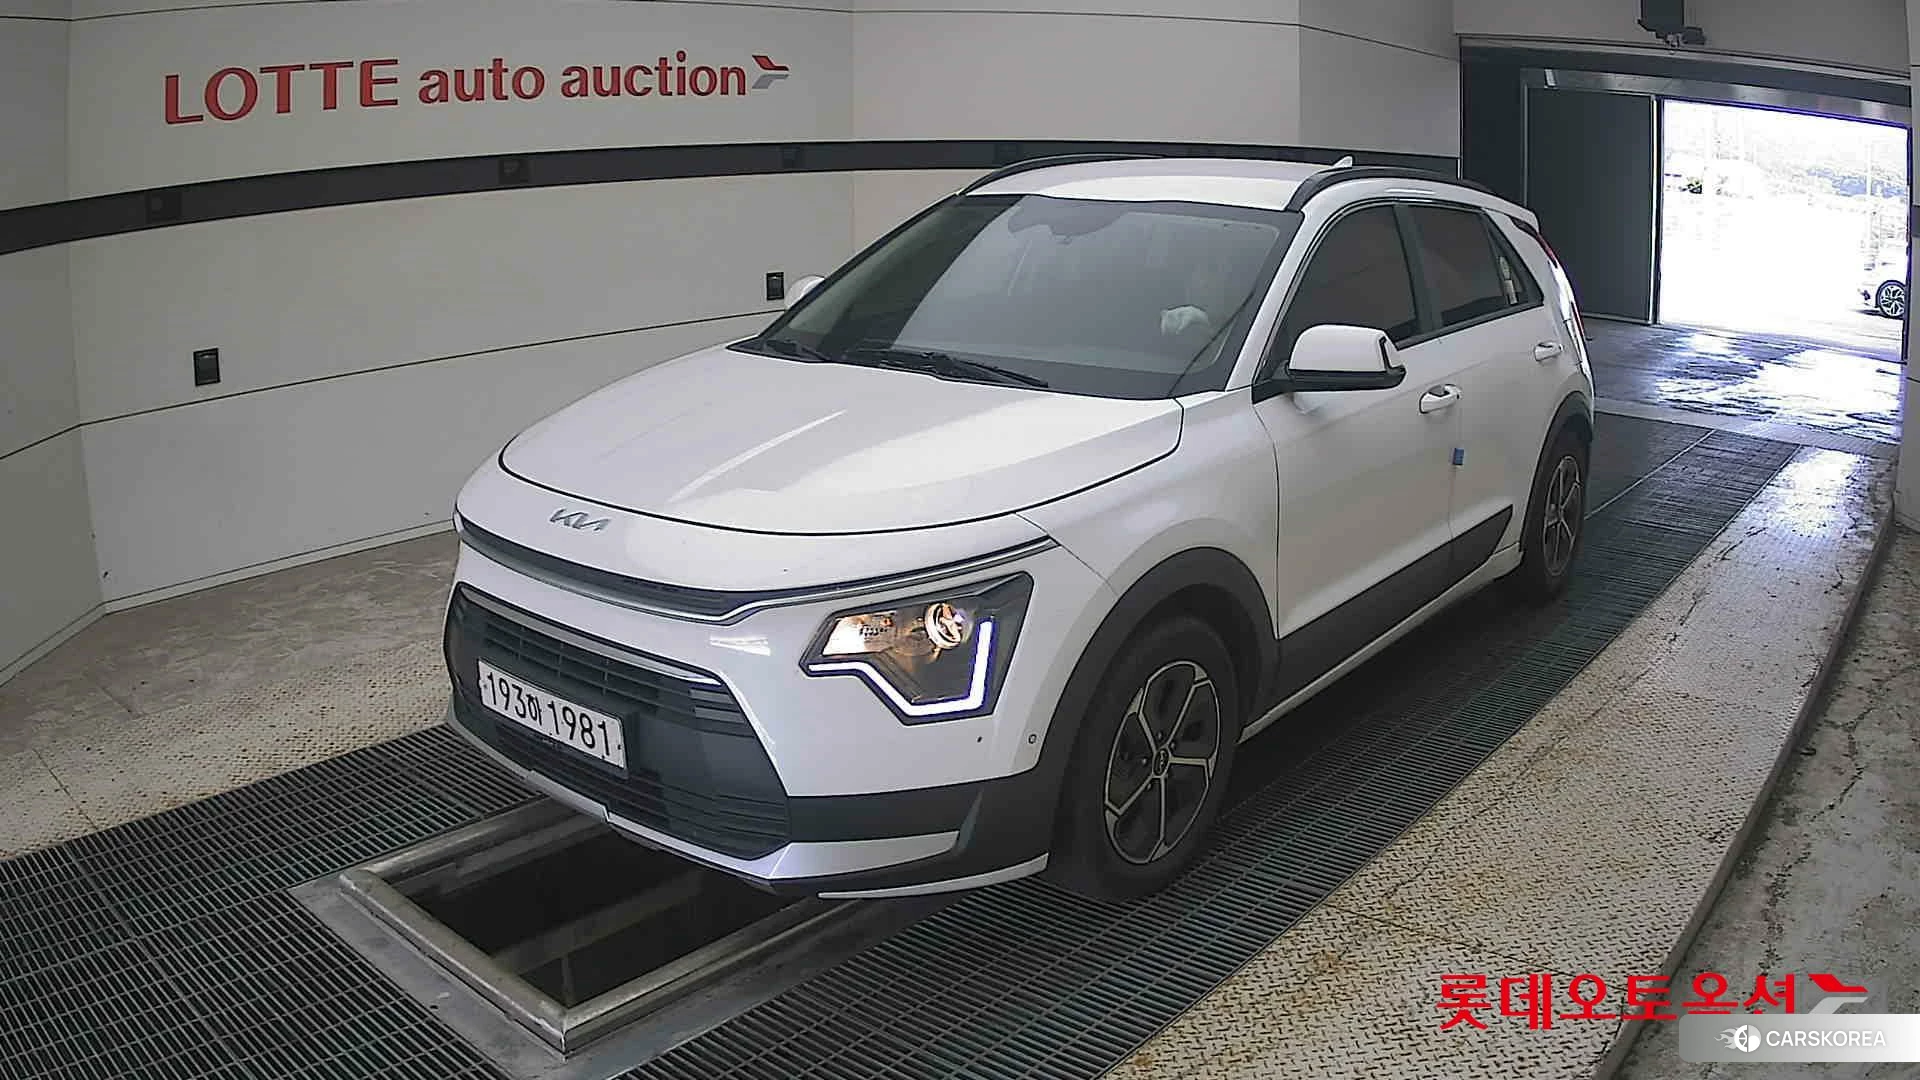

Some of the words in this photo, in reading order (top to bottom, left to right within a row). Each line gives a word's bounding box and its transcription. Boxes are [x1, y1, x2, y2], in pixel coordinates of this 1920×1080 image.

[165, 58, 399, 125] LOTTE
[418, 57, 546, 104] auto
[561, 50, 748, 98] auction
[549, 508, 609, 532] KIA
[488, 672, 543, 726] 193하
[548, 700, 610, 756] 1981
